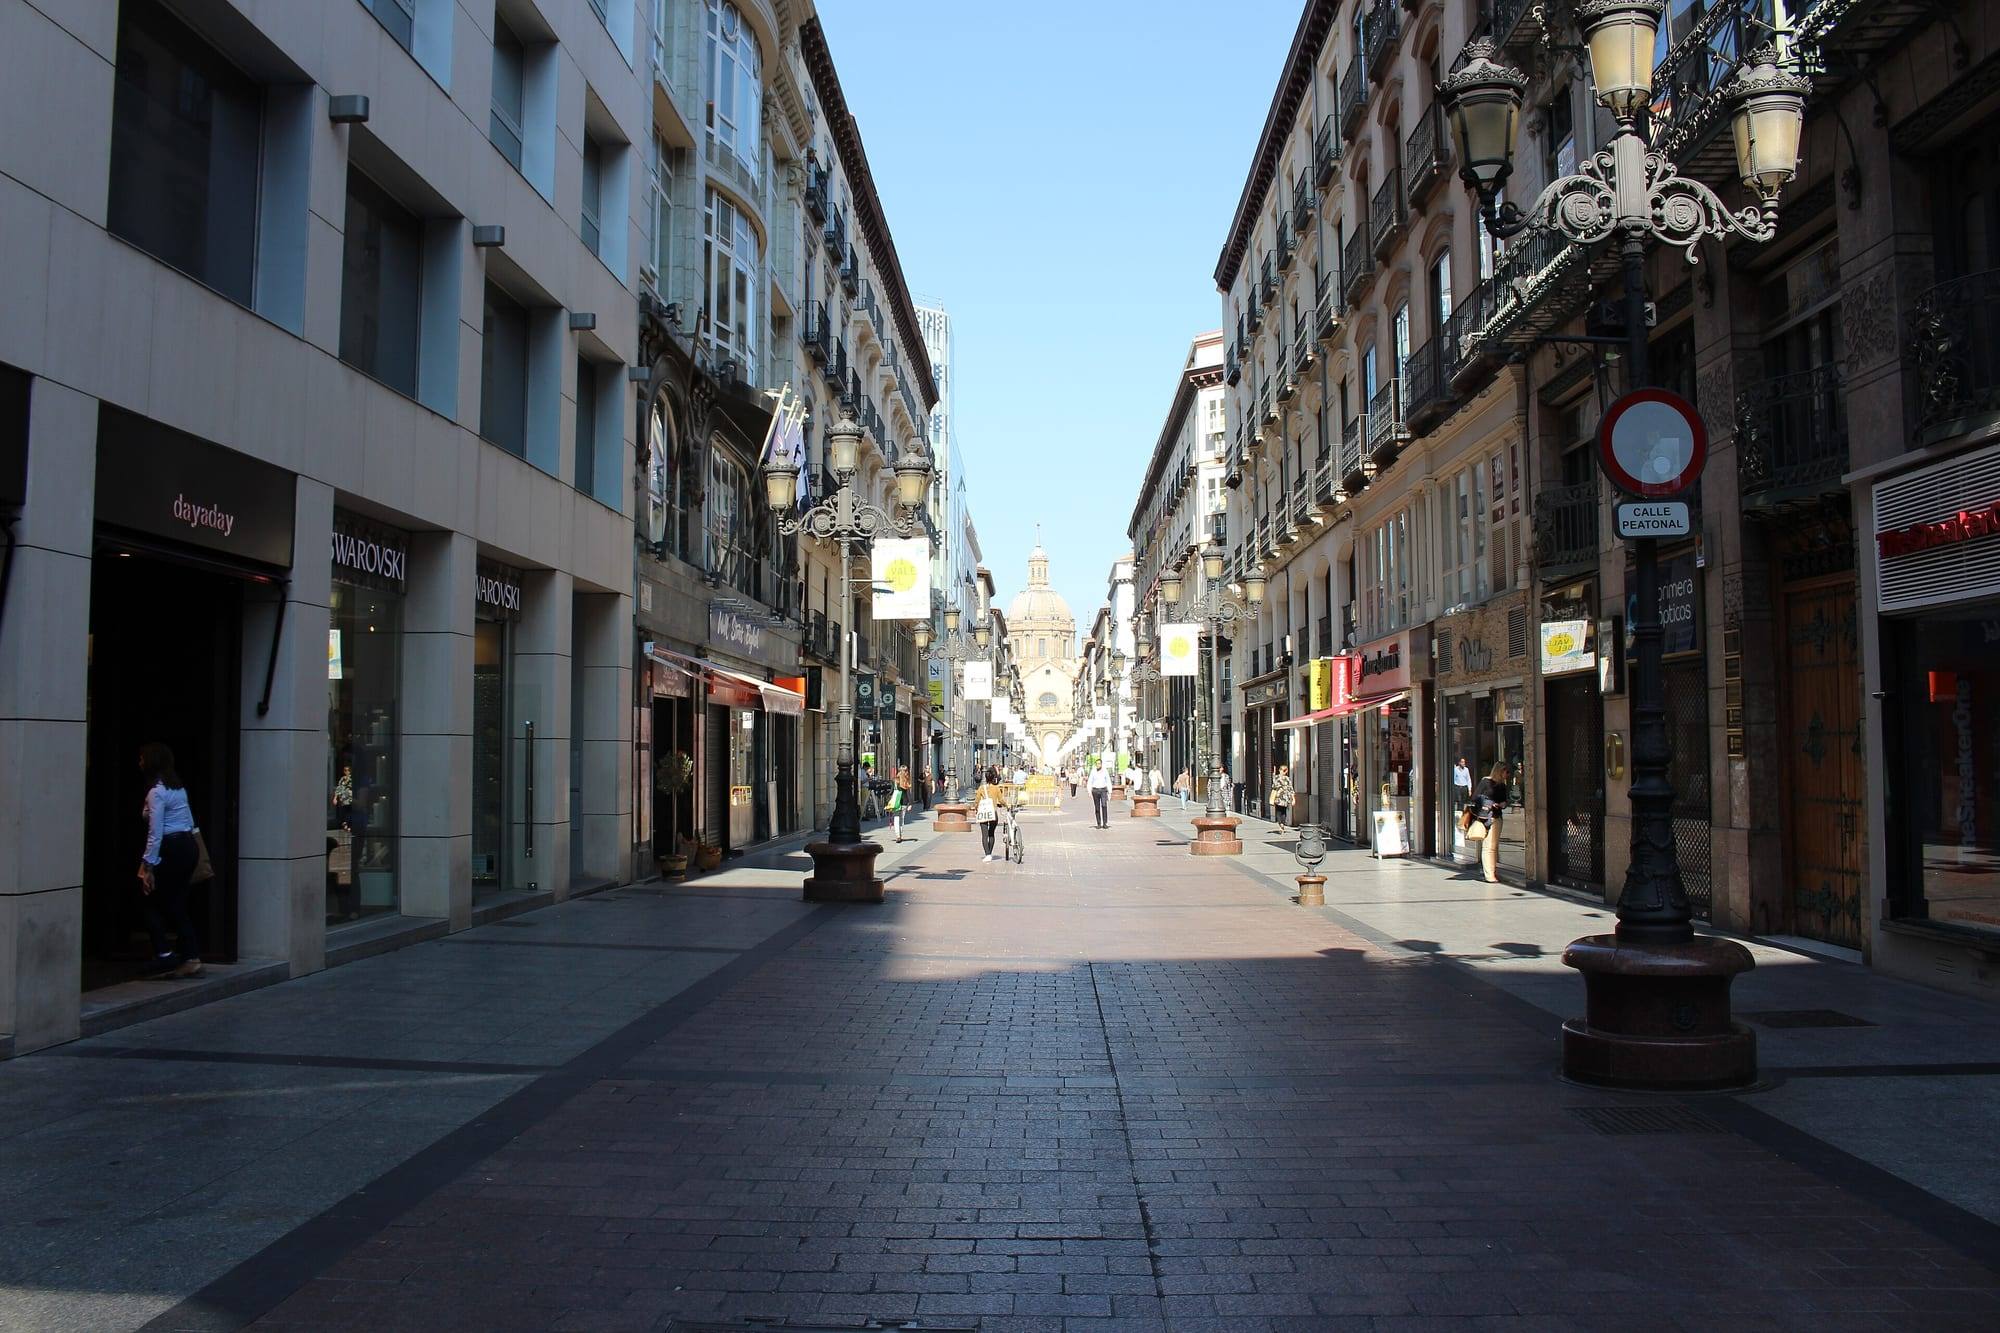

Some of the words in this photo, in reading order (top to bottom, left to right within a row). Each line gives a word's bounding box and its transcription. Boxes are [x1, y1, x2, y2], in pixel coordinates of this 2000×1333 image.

[173, 493, 235, 537] dayaday
[1633, 506, 1671, 517] CALLE
[1622, 519, 1683, 530] PEATONAL
